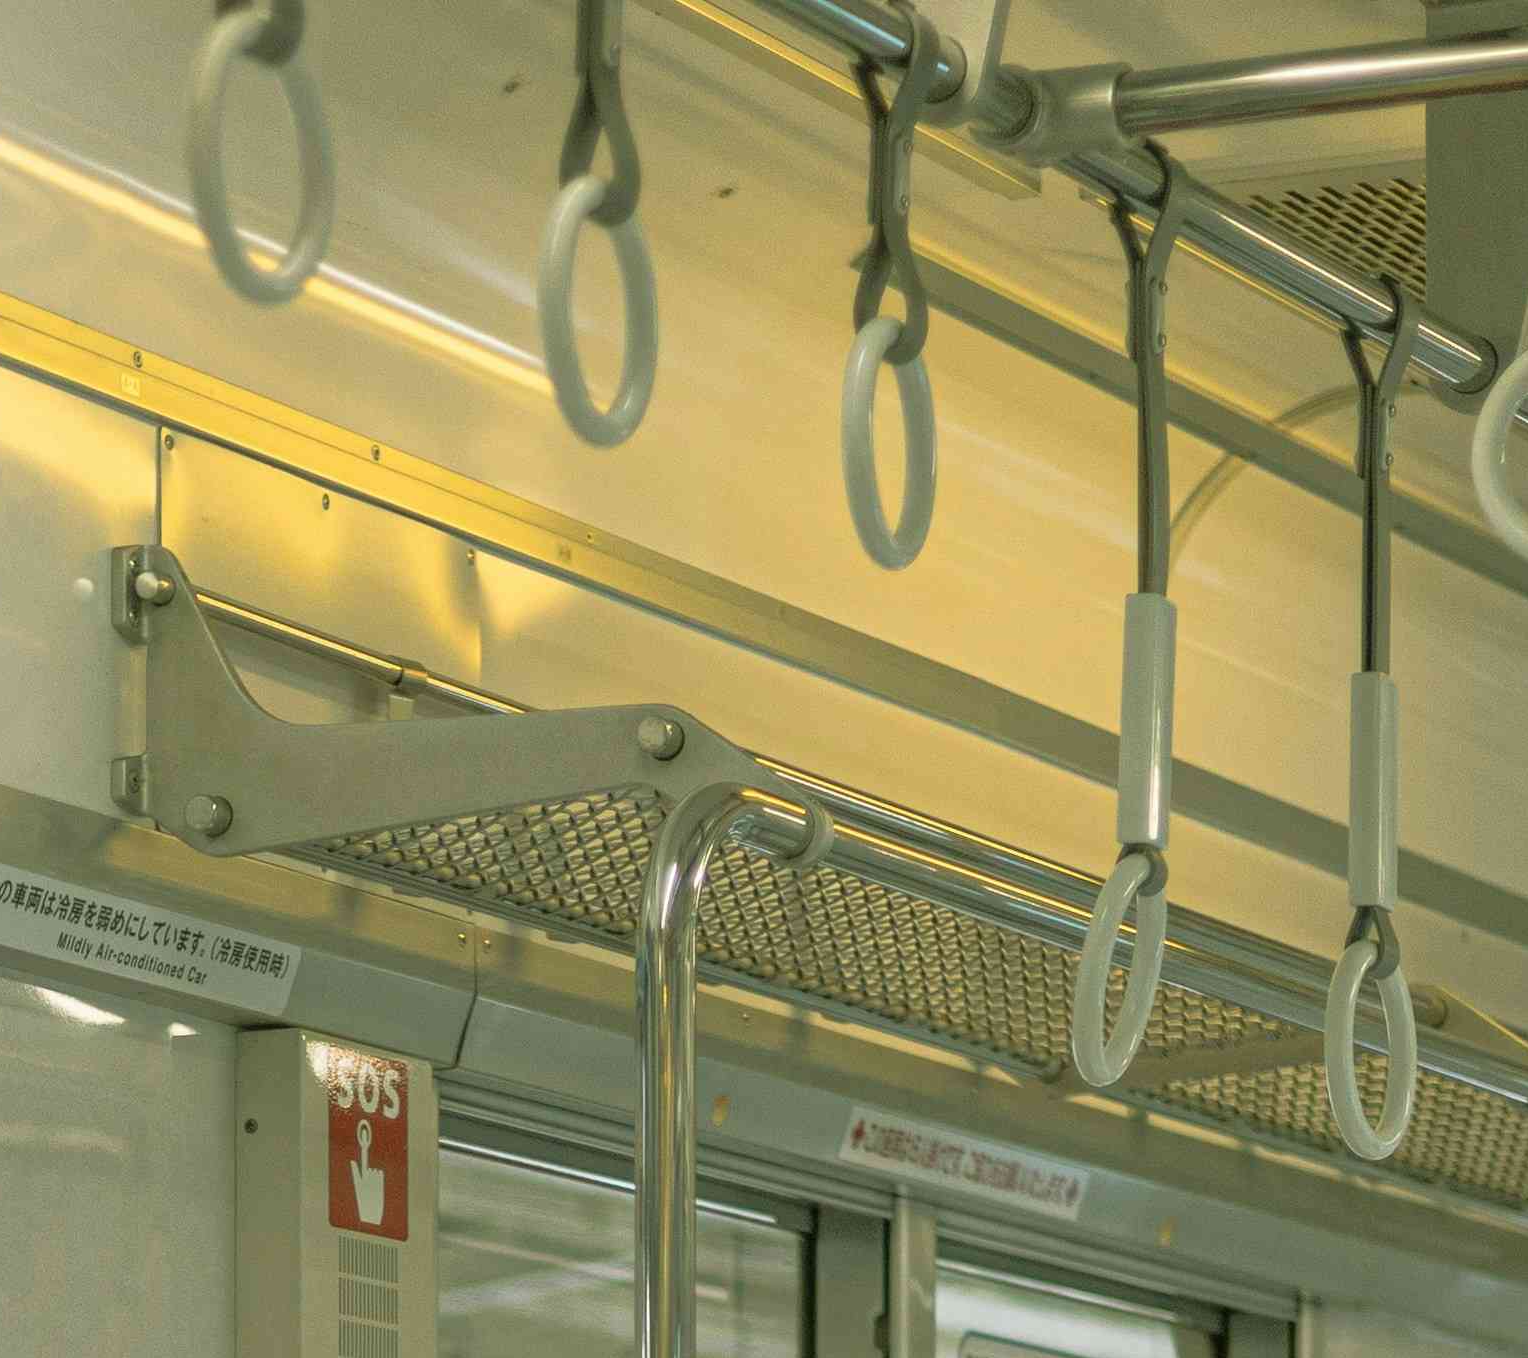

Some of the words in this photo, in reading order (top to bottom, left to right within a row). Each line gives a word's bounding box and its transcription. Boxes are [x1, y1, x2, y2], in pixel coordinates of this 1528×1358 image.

[57, 931, 91, 960] Mildly
[95, 941, 184, 980] Air-conditioned
[187, 969, 207, 985] Car
[338, 1062, 400, 1119] SOS
